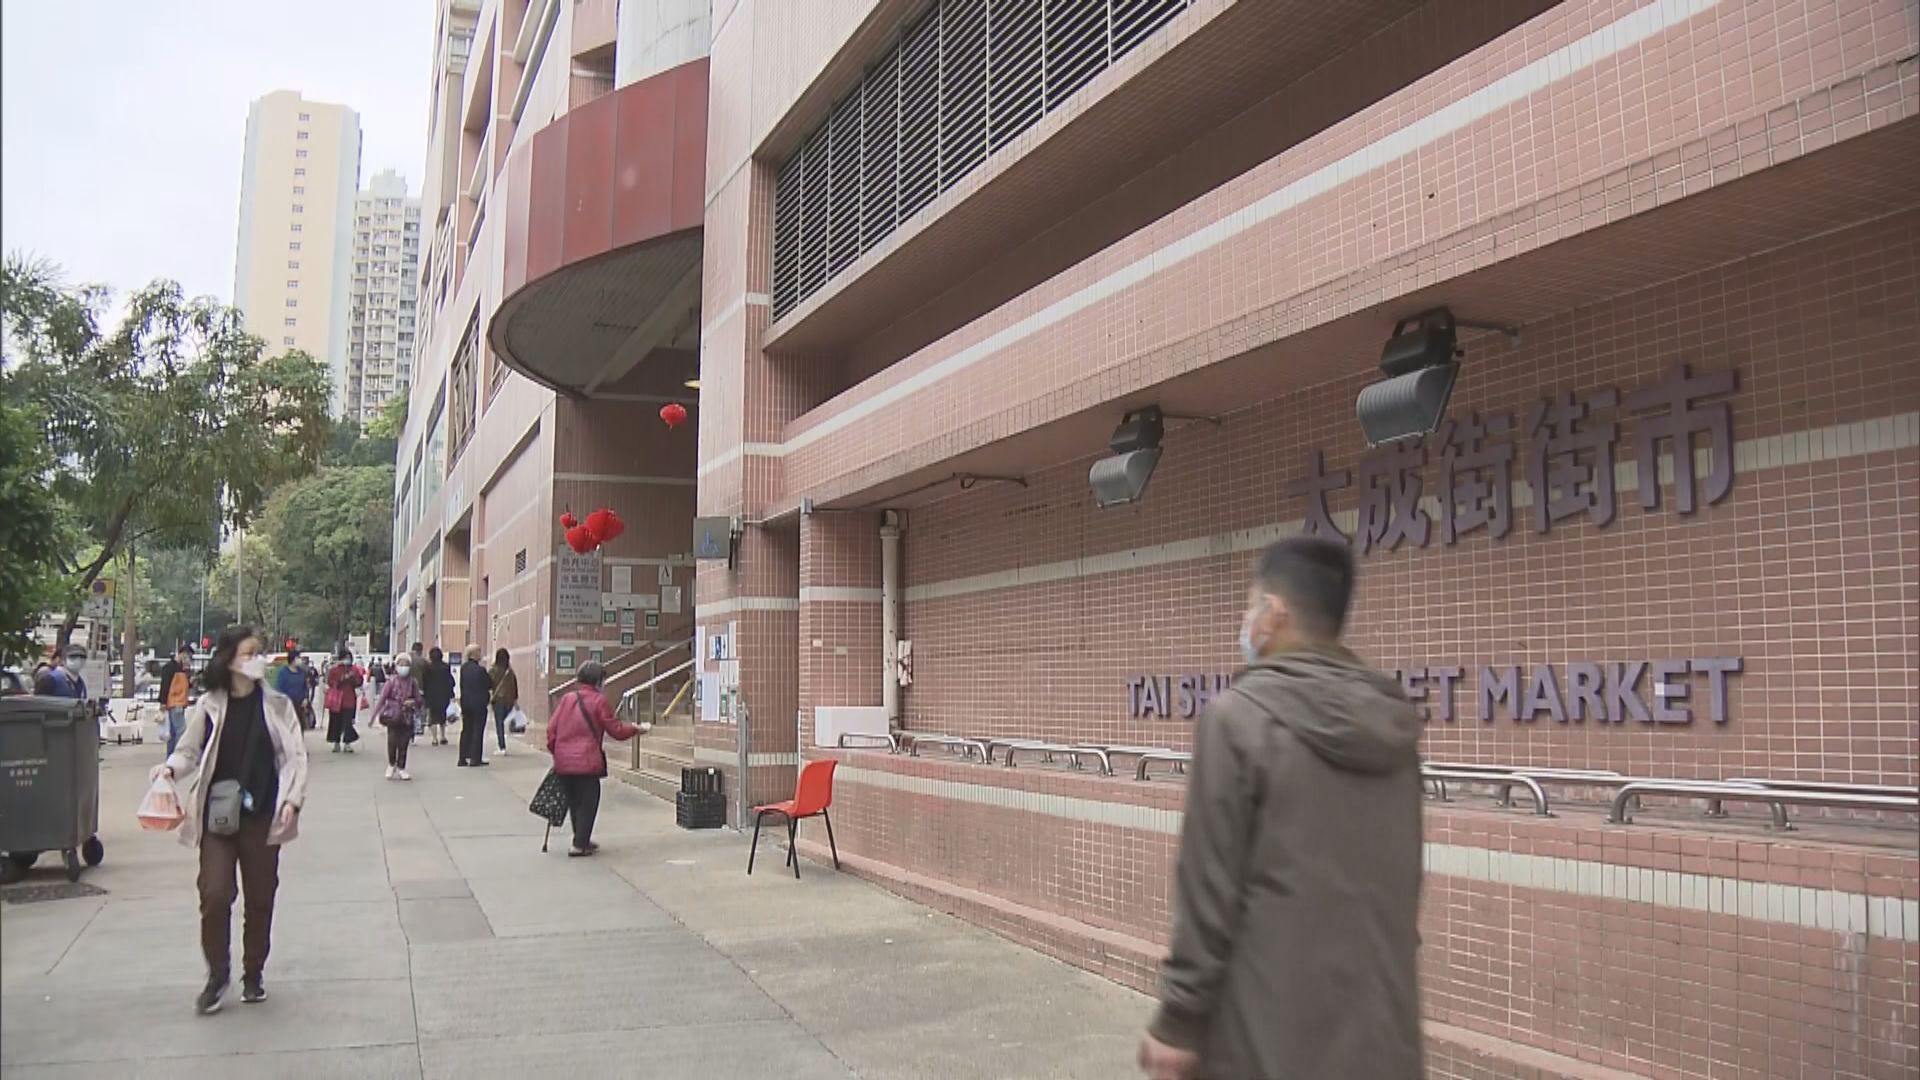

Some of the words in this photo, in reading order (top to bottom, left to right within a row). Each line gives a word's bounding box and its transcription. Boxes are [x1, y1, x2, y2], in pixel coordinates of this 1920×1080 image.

[1288, 363, 1740, 555] 大成街街市
[1126, 672, 1171, 720] TAI
[1478, 656, 1744, 725] MARKET
